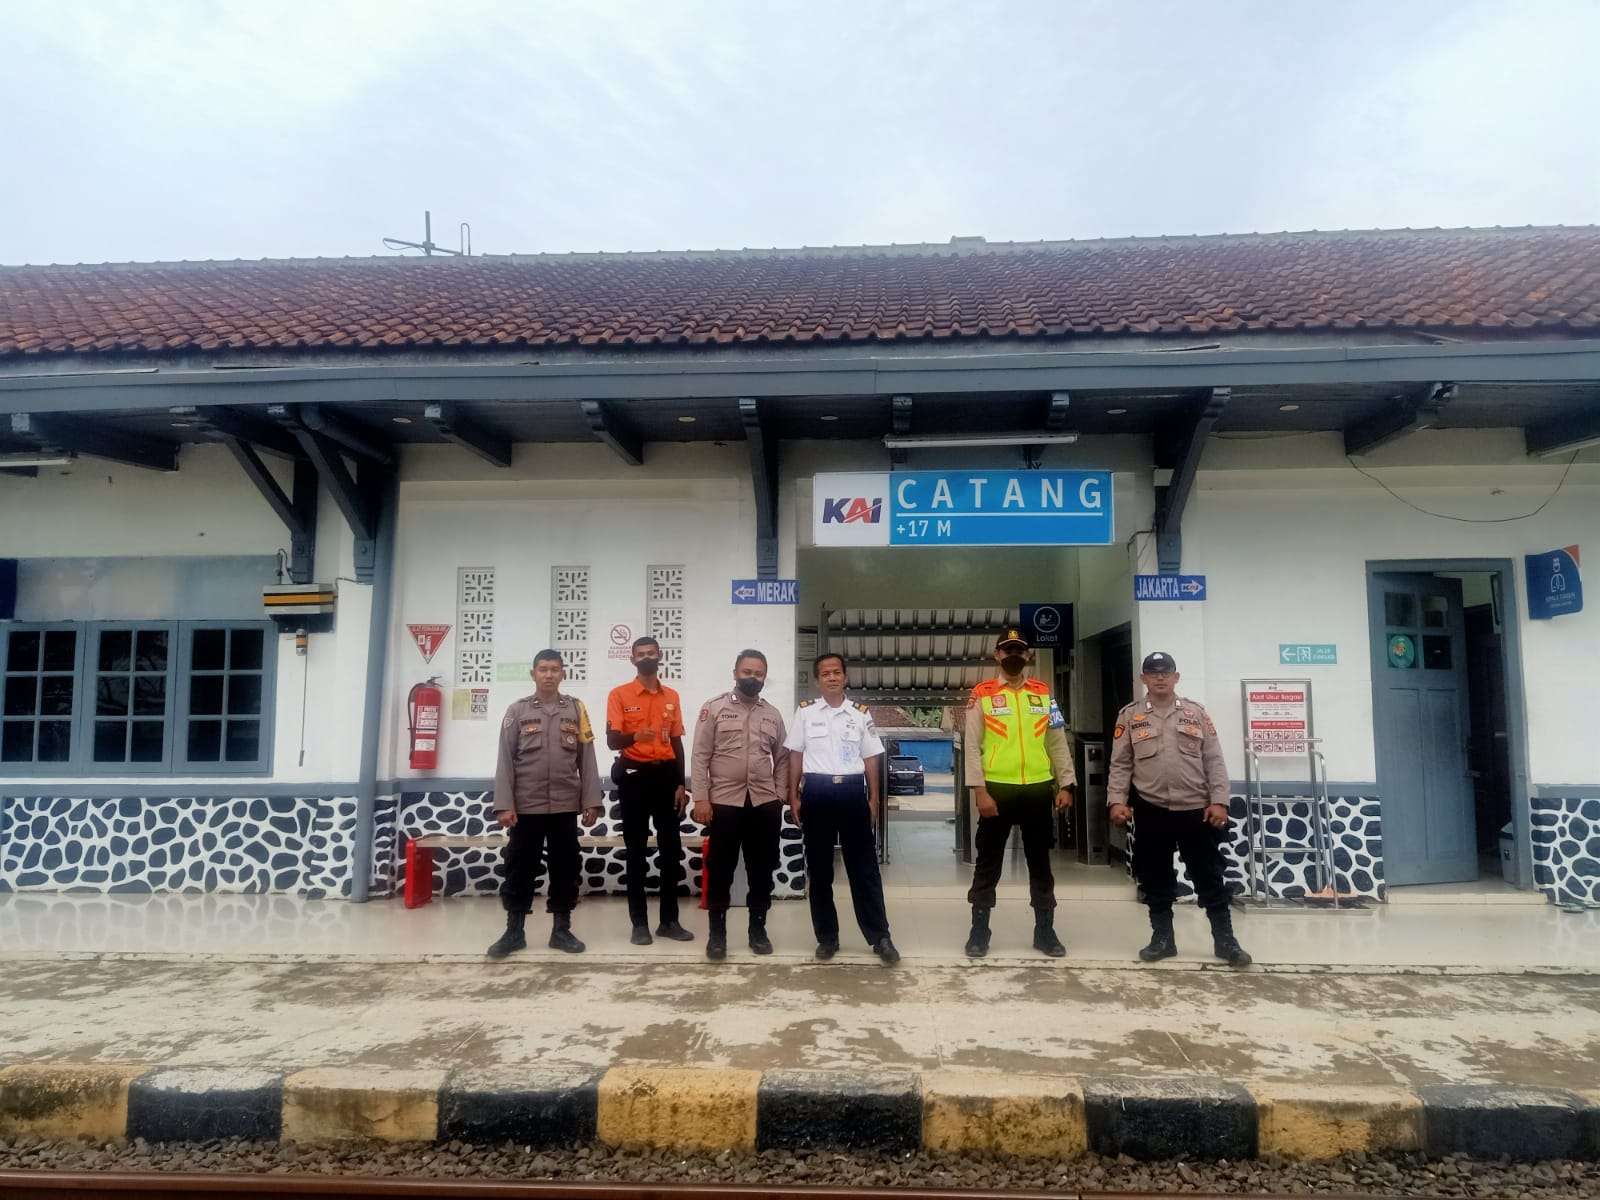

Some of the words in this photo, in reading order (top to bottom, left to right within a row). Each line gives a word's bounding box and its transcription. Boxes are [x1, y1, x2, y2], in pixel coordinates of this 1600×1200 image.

[897, 478, 1102, 510] CATANG
[822, 497, 882, 524] KAI
[897, 520, 929, 538] +17
[937, 520, 951, 537] M
[757, 582, 796, 602] MERAK
[1136, 577, 1180, 598] JAKARTA
